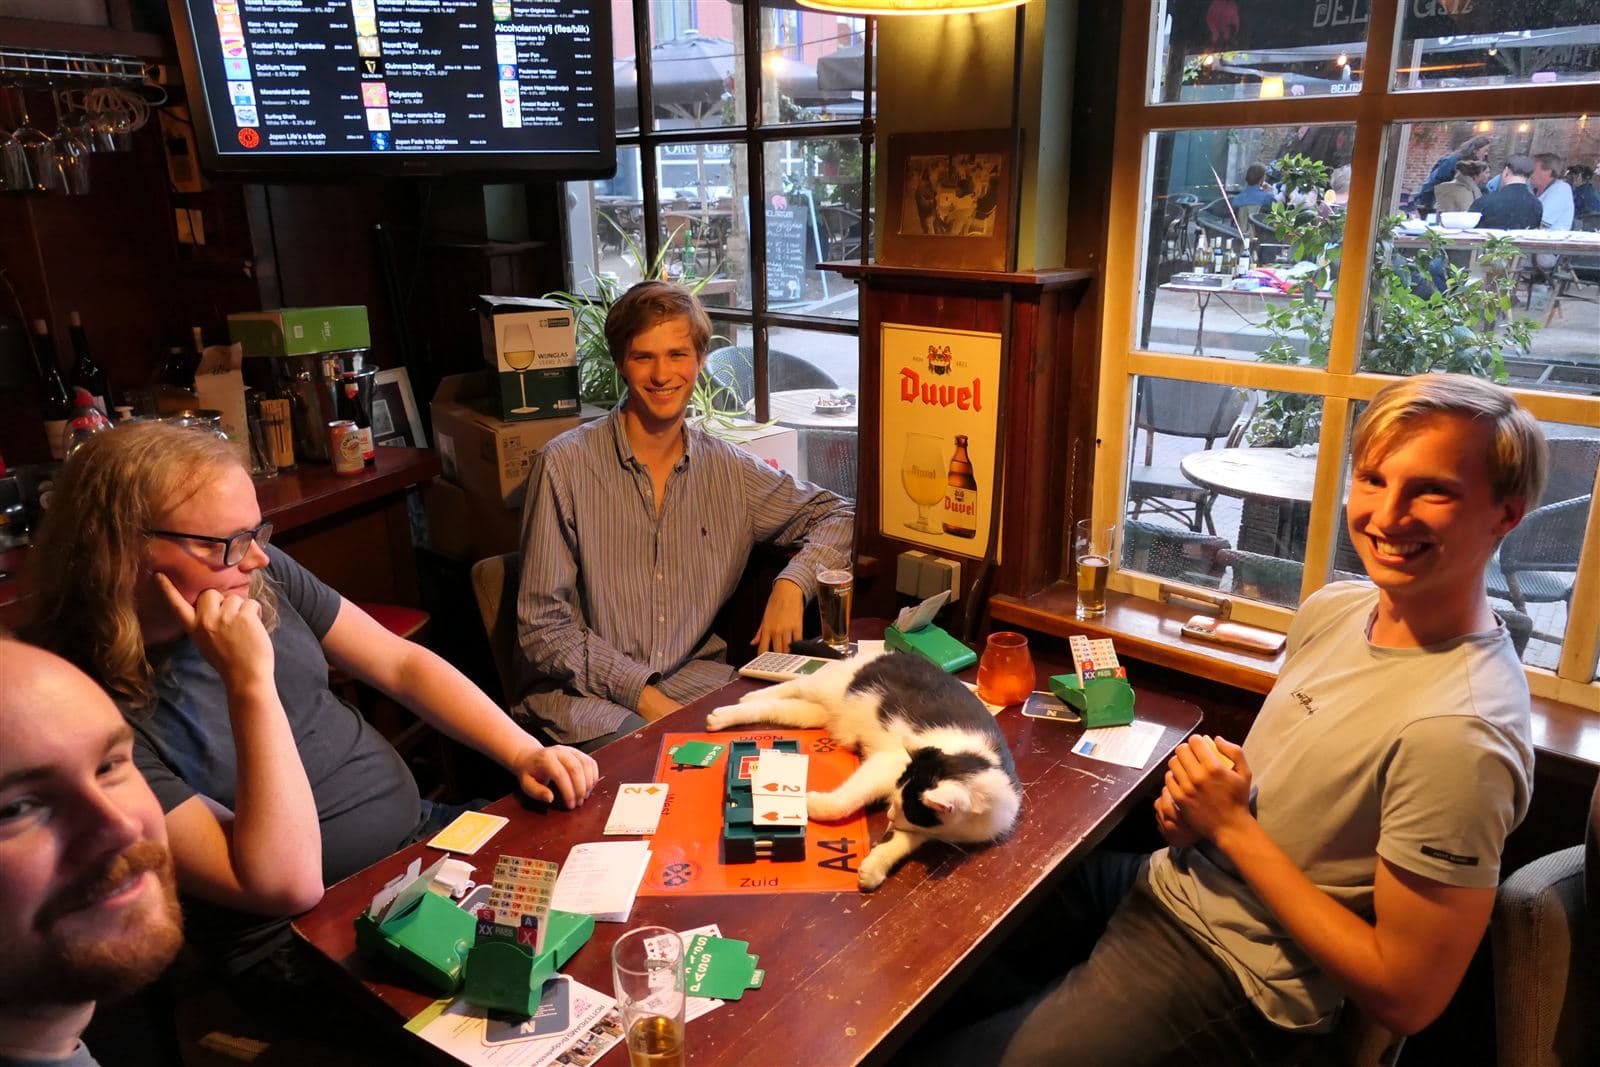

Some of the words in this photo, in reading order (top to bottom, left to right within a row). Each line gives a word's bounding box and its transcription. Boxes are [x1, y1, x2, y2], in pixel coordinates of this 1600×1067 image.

[495, 24, 552, 34] Alcoholarm/vrij
[554, 25, 590, 35] (fles/blik)
[900, 367, 982, 412] Duvel
[944, 496, 976, 516] Duvel
[817, 837, 858, 873] A4
[740, 877, 778, 887] Zuid
[525, 917, 532, 926] A
[479, 924, 493, 935] XX
[495, 928, 514, 937] PASS
[522, 930, 532, 944] X
[690, 953, 712, 992] PASS
